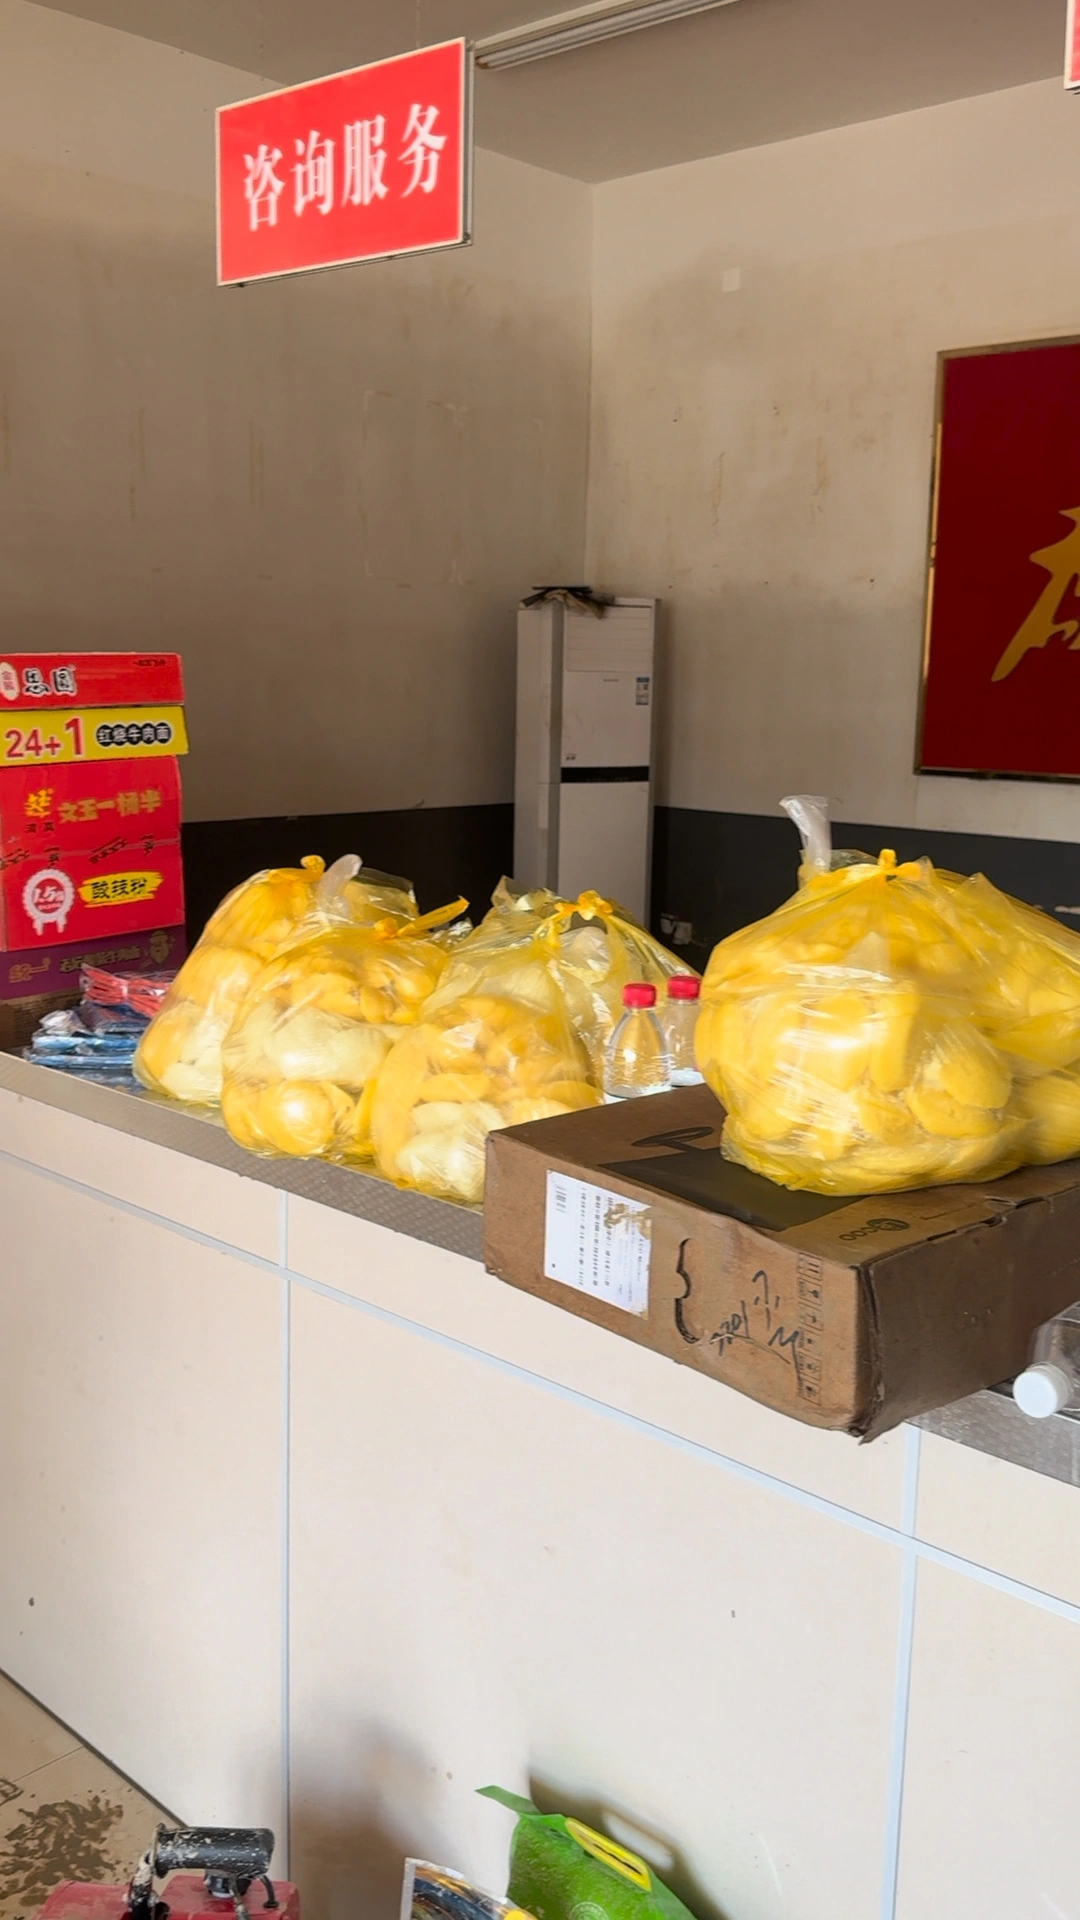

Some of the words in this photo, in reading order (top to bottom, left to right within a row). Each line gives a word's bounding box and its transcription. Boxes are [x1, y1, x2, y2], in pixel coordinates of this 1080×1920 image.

[243, 103, 448, 232] 咨询服务
[5, 716, 84, 759] 24+1
[97, 724, 171, 746] 红烧牛肉面
